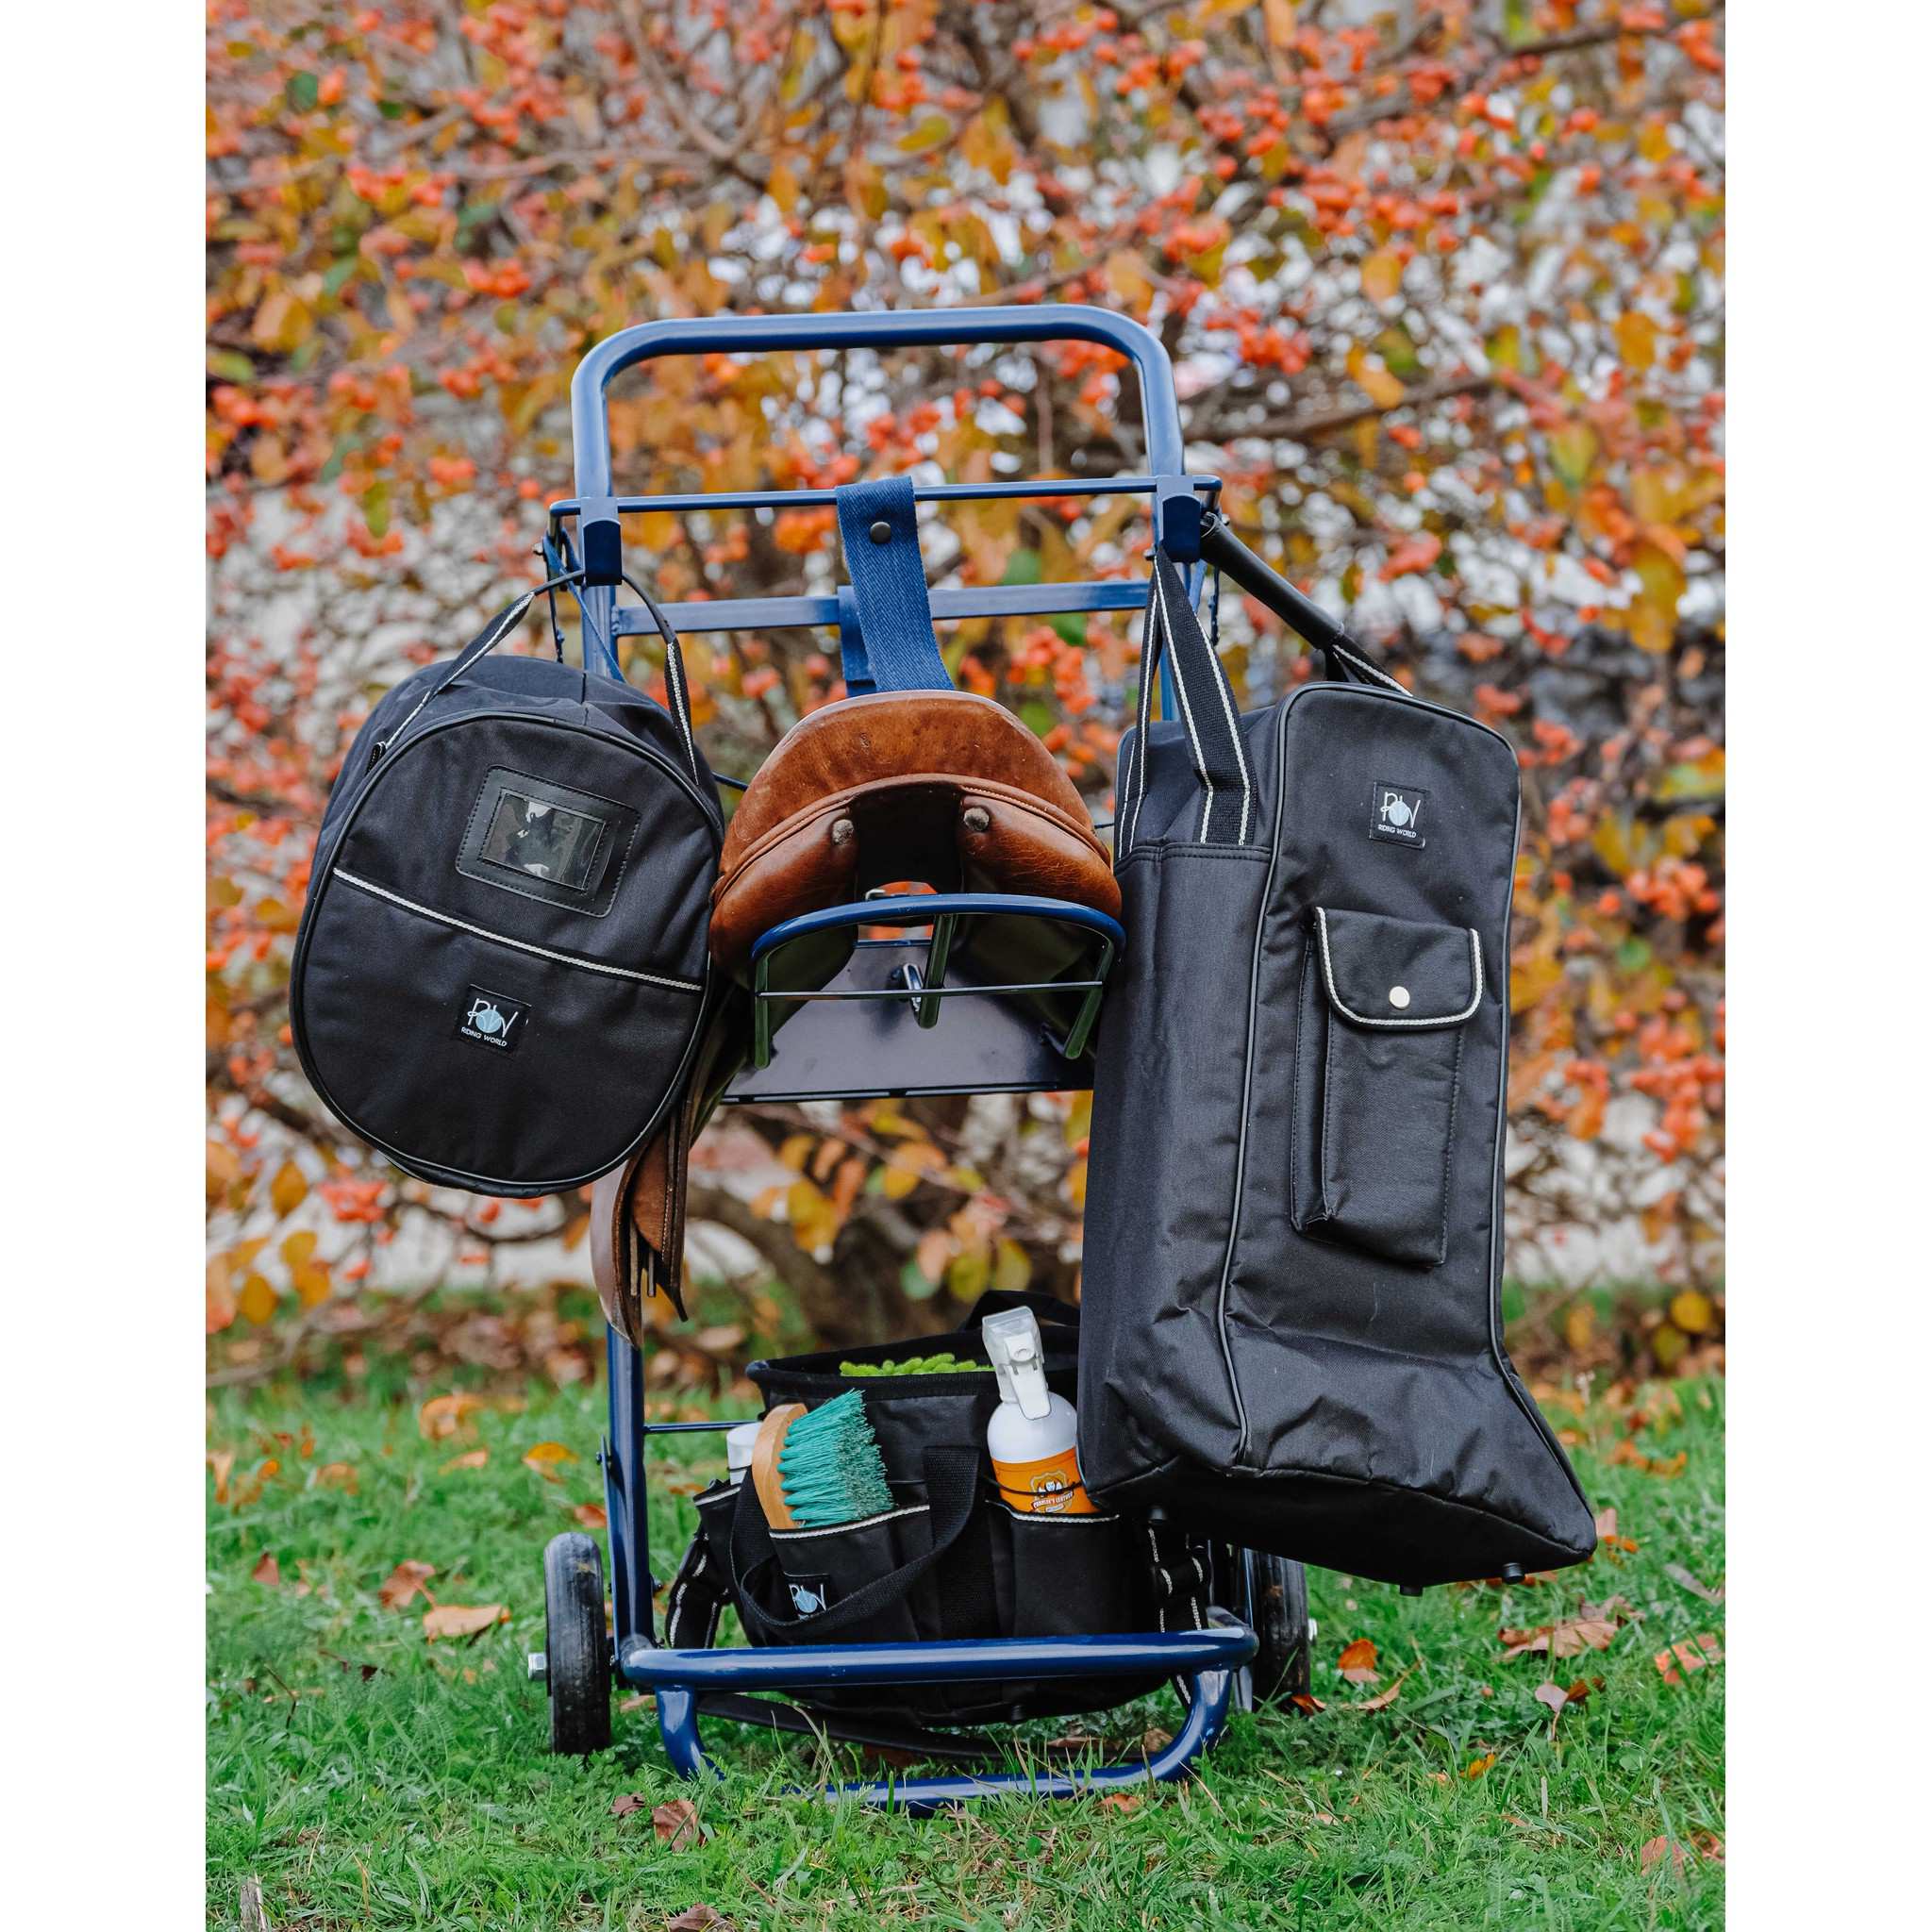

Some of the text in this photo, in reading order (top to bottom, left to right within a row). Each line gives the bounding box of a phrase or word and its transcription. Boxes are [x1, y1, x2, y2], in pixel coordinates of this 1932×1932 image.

[1396, 828, 1417, 839] WORLD
[460, 1026, 508, 1047] RIDING WORLD
